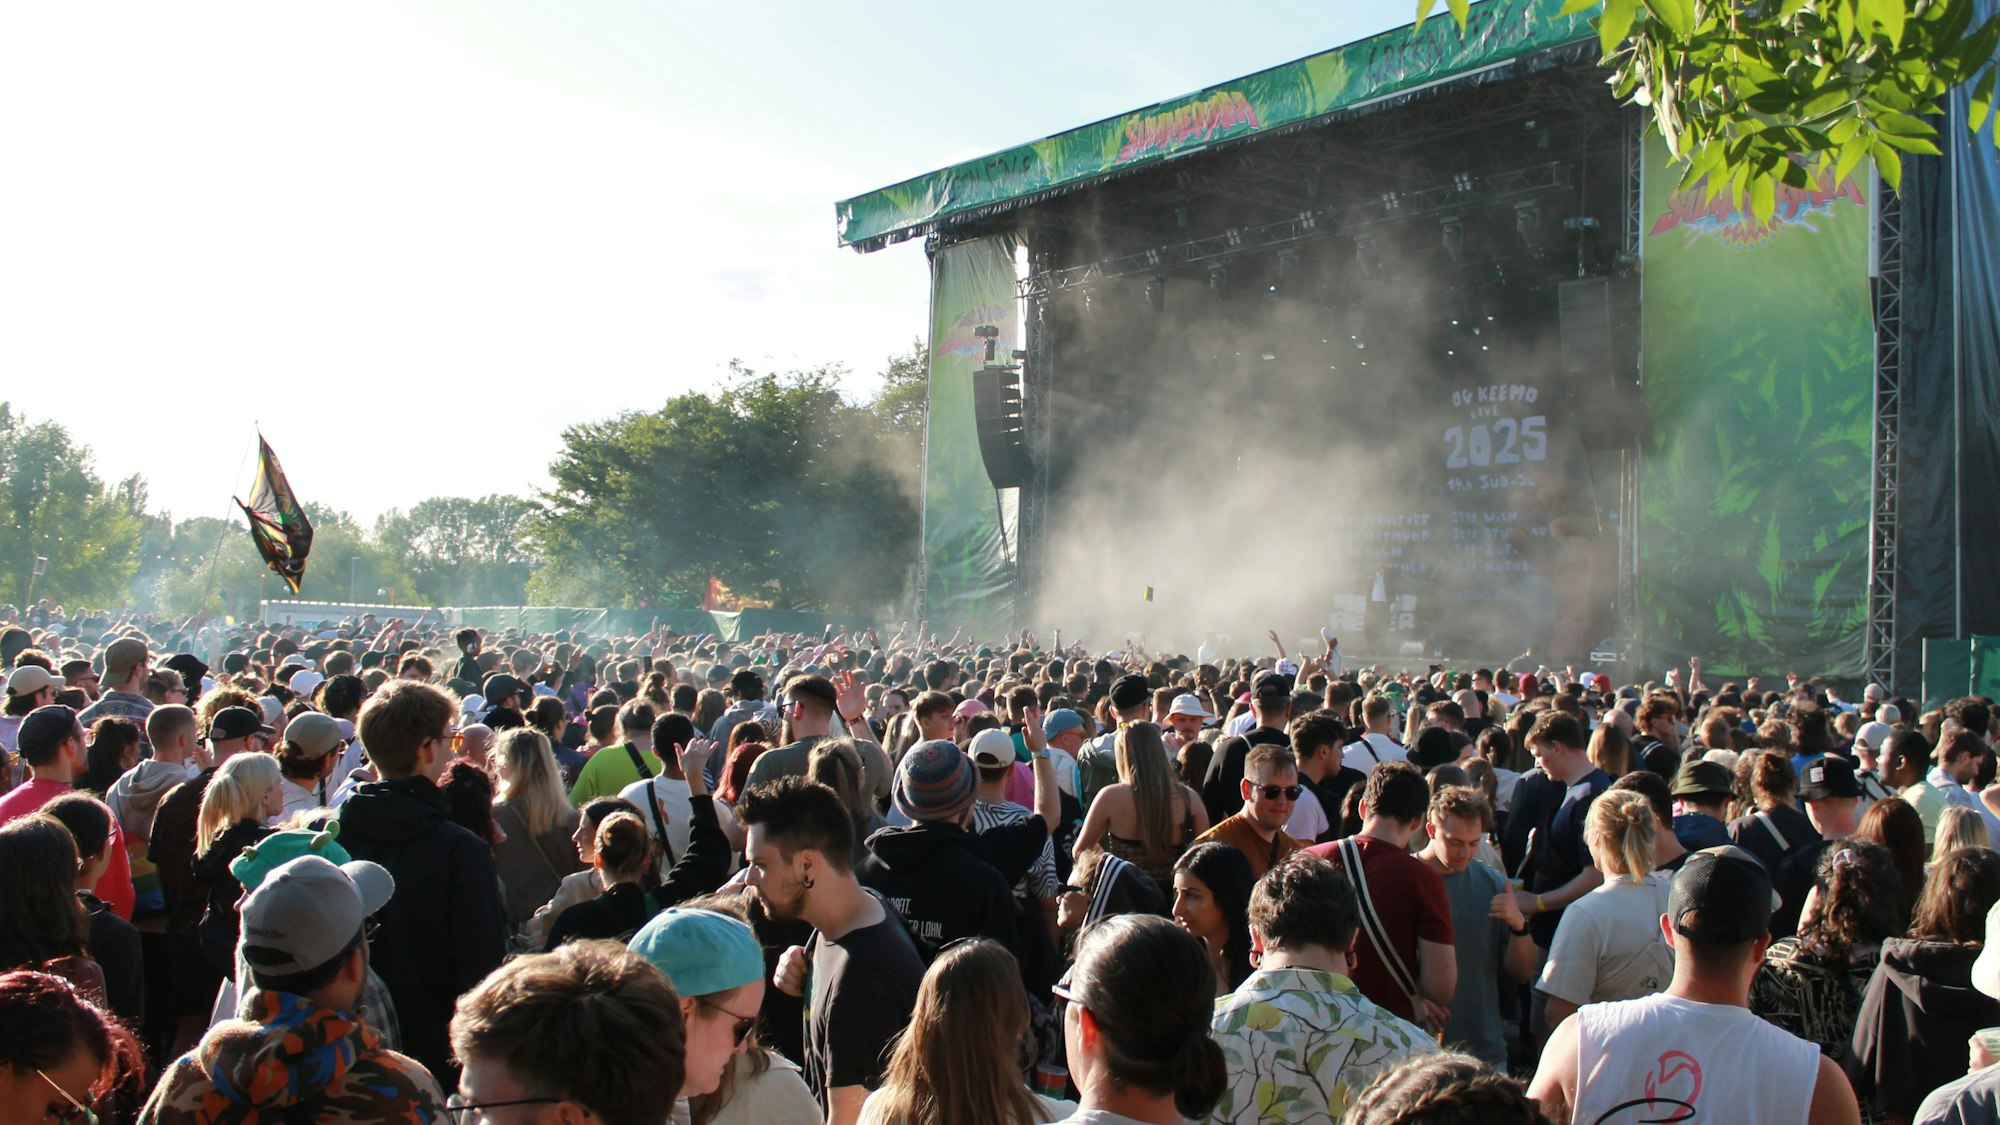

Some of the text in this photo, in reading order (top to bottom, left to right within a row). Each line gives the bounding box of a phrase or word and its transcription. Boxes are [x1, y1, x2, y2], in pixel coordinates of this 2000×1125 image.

[1477, 384, 1538, 403] KEEMO
[1443, 415, 1547, 469] 2025
[920, 920, 944, 940] LOHN.
